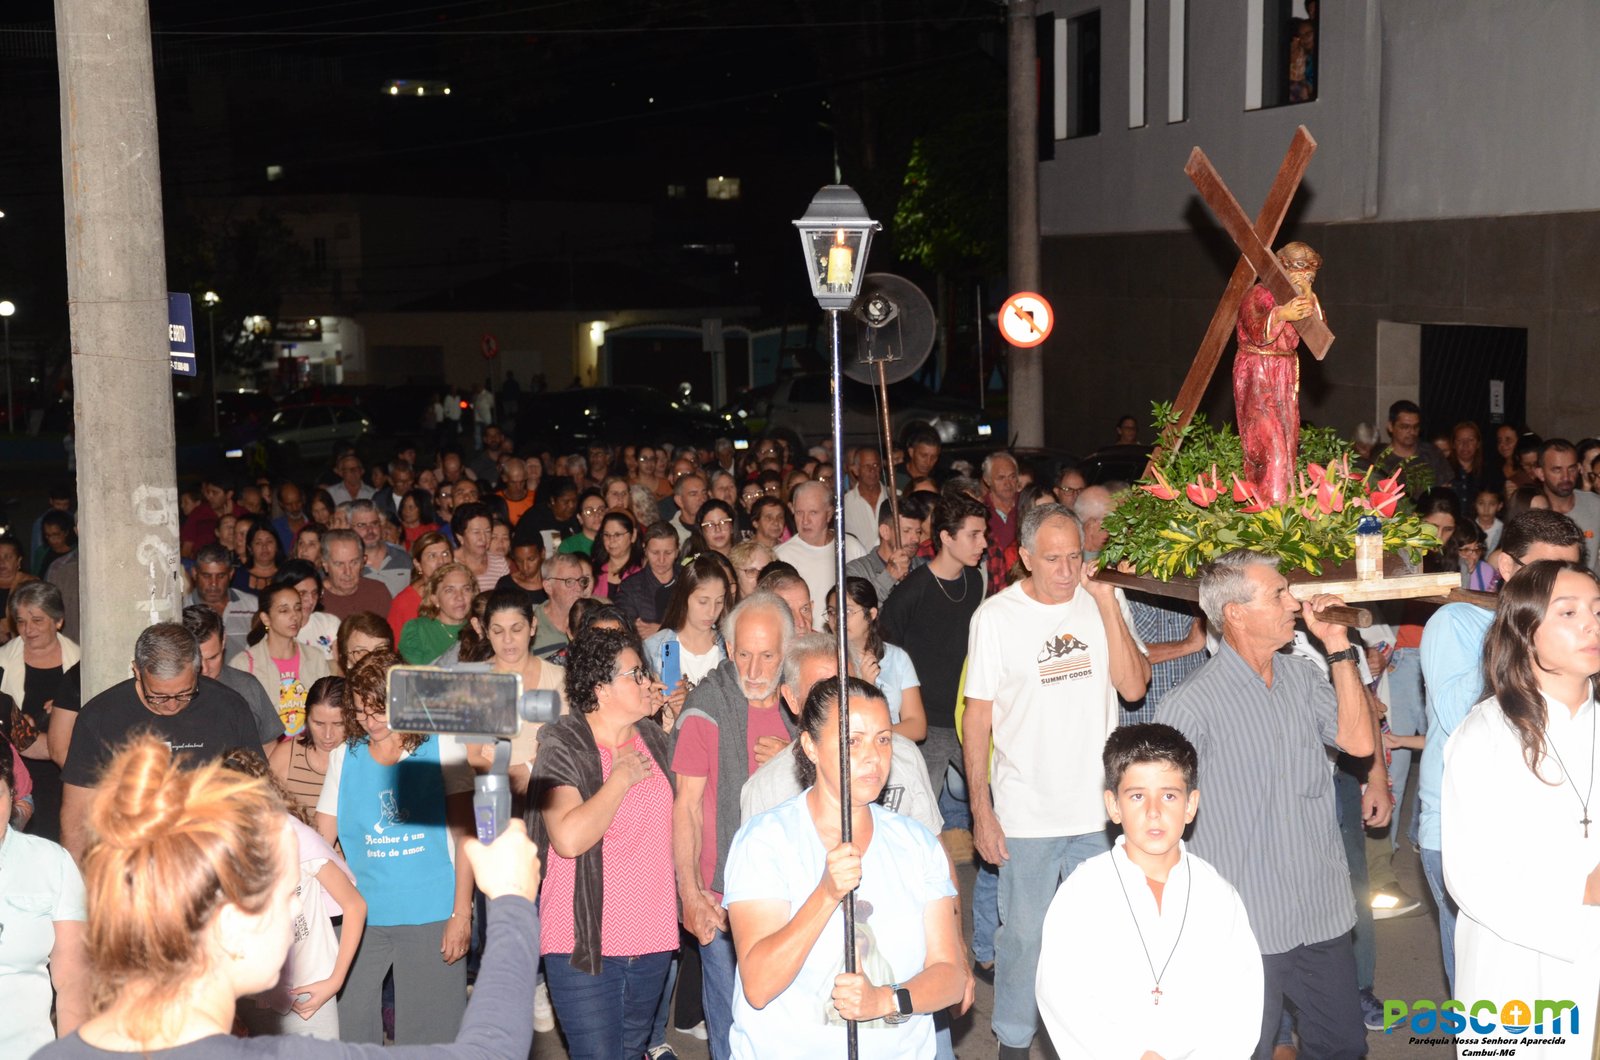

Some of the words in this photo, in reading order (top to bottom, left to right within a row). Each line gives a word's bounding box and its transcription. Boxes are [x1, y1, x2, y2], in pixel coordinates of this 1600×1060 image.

[1041, 674, 1068, 684] SUMMIT
[1069, 669, 1092, 679] GOODS
[365, 834, 400, 845] Acolher
[402, 833, 409, 842] é
[411, 832, 425, 841] um
